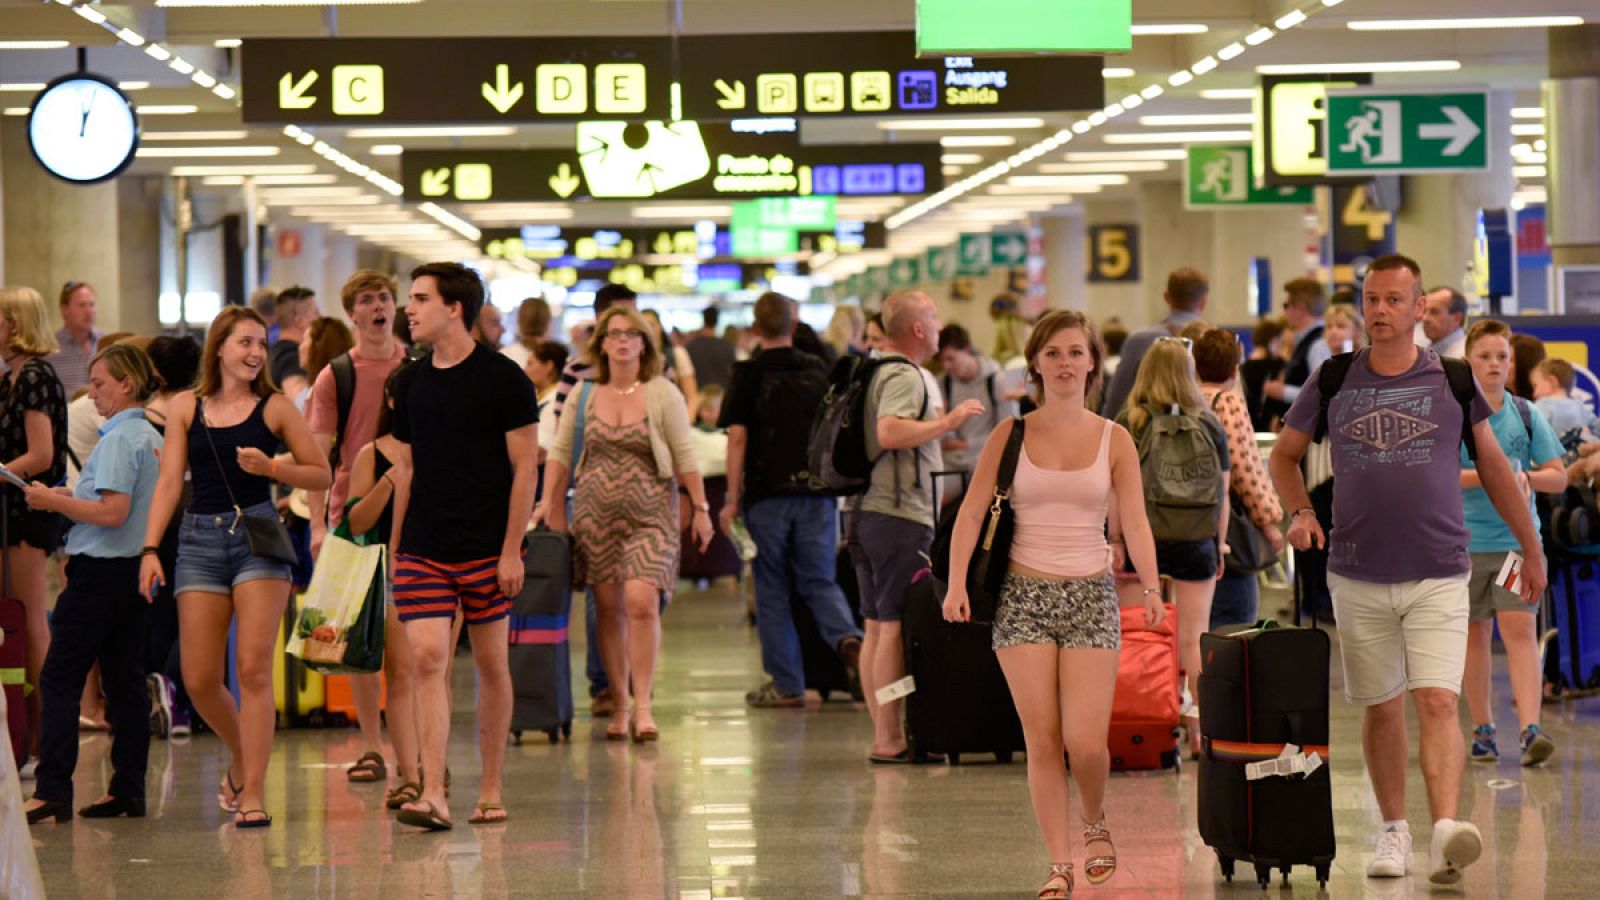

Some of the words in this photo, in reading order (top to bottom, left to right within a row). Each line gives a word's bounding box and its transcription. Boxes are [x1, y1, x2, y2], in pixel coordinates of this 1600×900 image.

[348, 75, 368, 102] C
[553, 75, 572, 101] D
[613, 75, 630, 101] E
[945, 69, 1007, 88] Ausgang
[770, 86, 785, 104] P
[946, 87, 999, 104] Salida
[1342, 184, 1391, 241] 4
[1097, 229, 1131, 279] 5
[1352, 413, 1420, 445] SUPER
